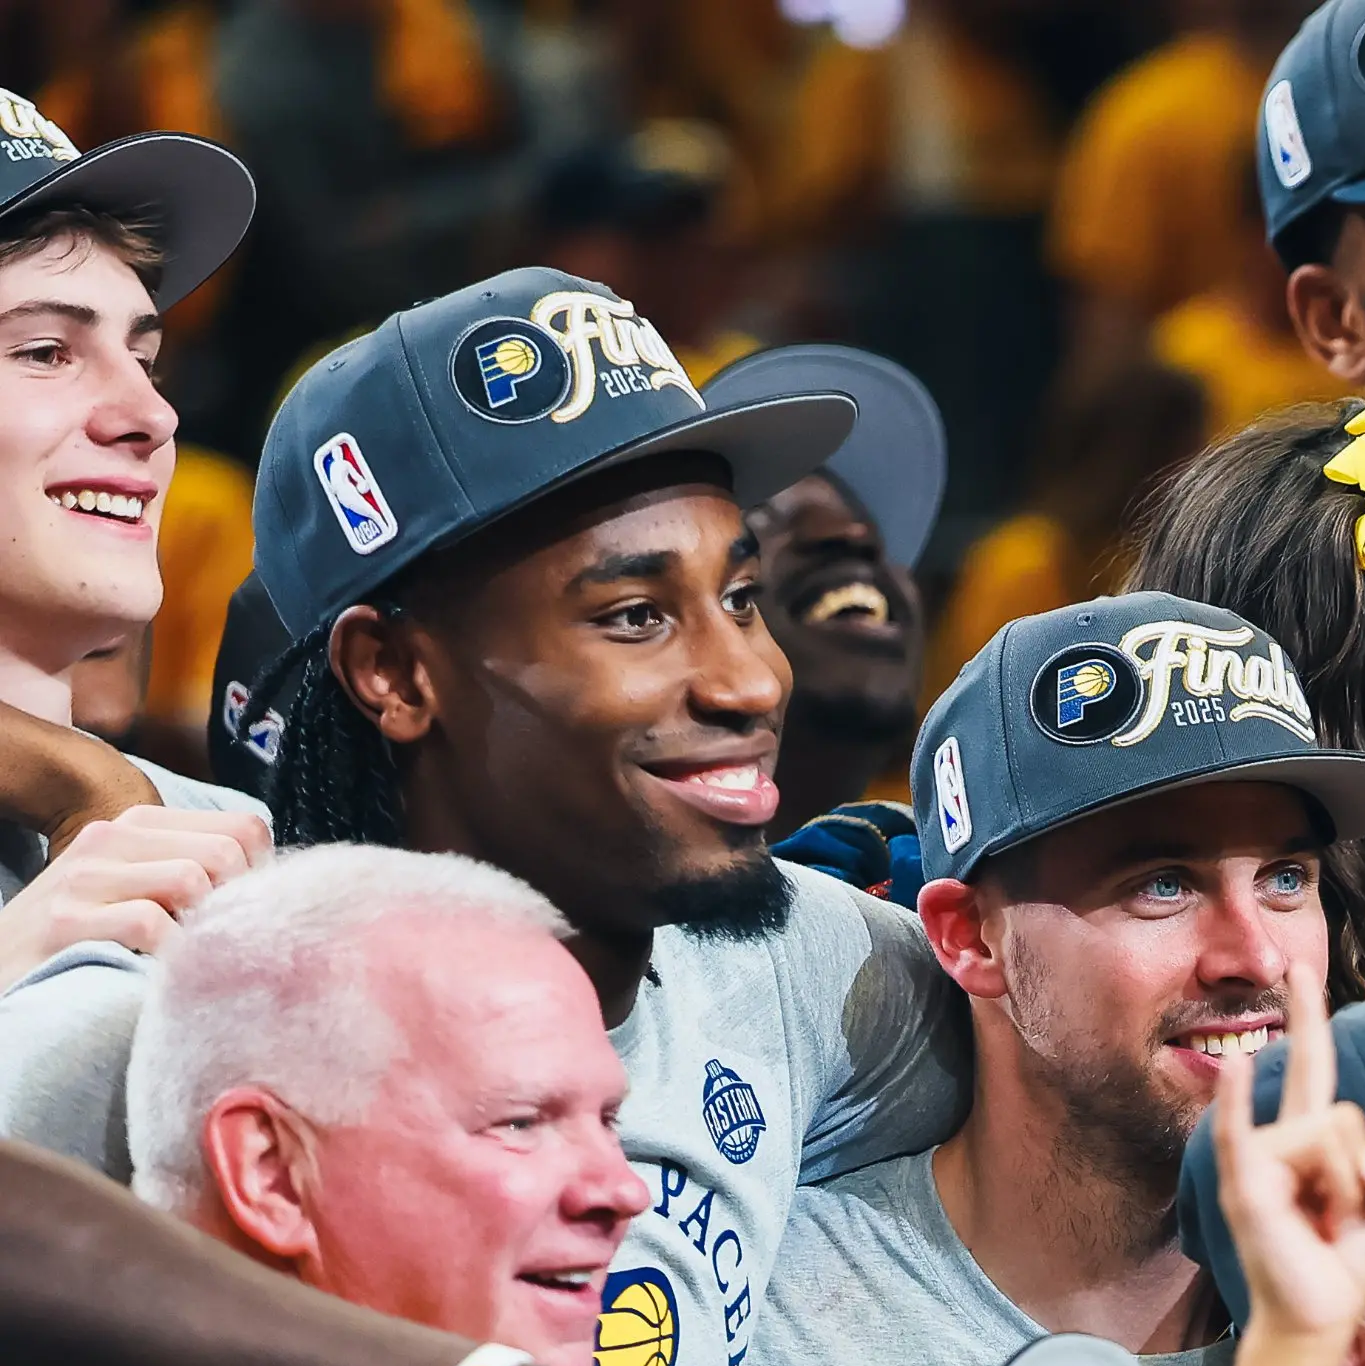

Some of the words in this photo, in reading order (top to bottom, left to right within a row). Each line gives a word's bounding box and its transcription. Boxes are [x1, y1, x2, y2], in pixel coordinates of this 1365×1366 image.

[600, 366, 652, 398] 2025
[1173, 697, 1226, 727] 2025
[705, 1088, 760, 1144] EASTERN
